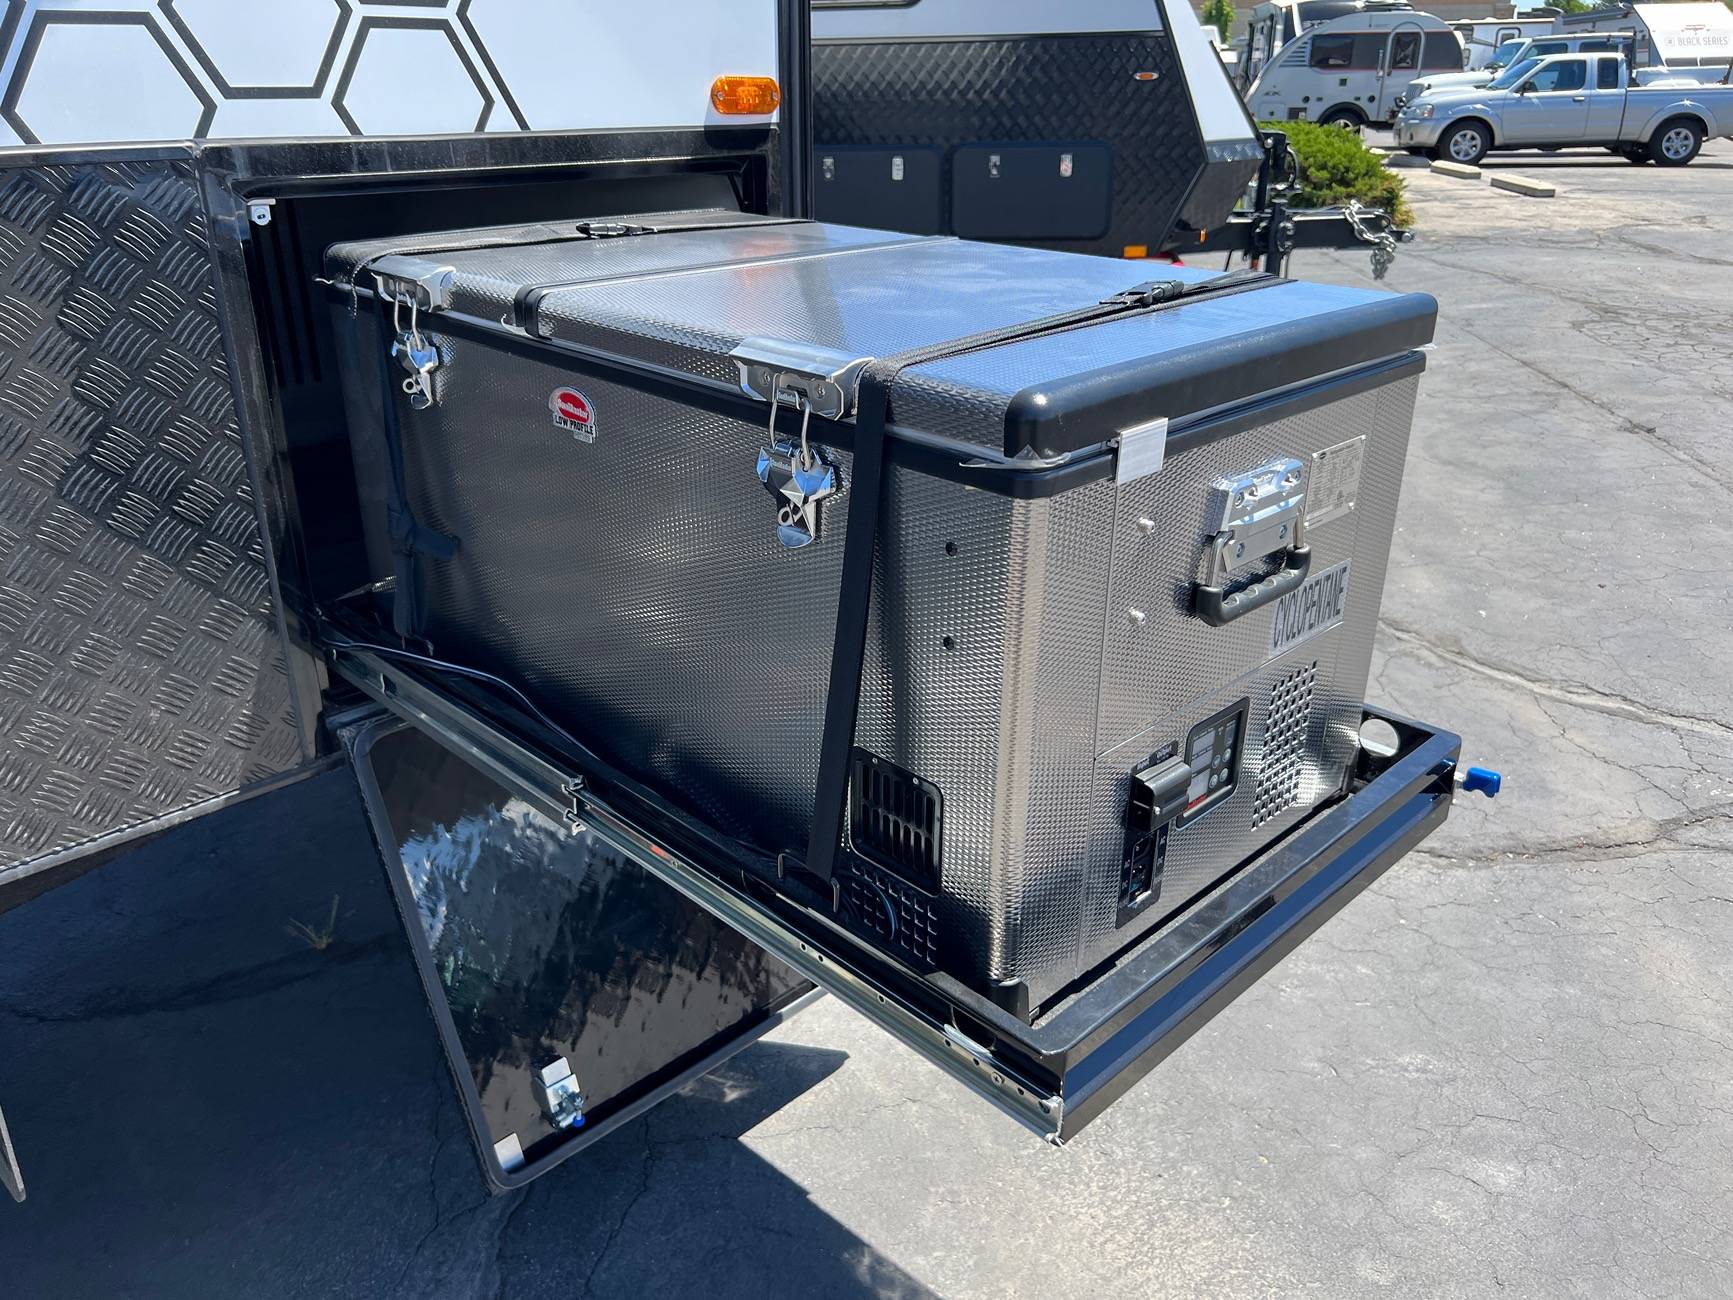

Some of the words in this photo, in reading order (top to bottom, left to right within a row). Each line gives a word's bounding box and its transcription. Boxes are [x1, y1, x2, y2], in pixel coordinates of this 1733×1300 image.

[1678, 36, 1701, 46] BLACK
[1703, 35, 1728, 46] SERIES
[554, 414, 569, 428] LOW
[569, 418, 594, 436] PROFILE
[1273, 566, 1347, 648] CYCLOPENTANE
